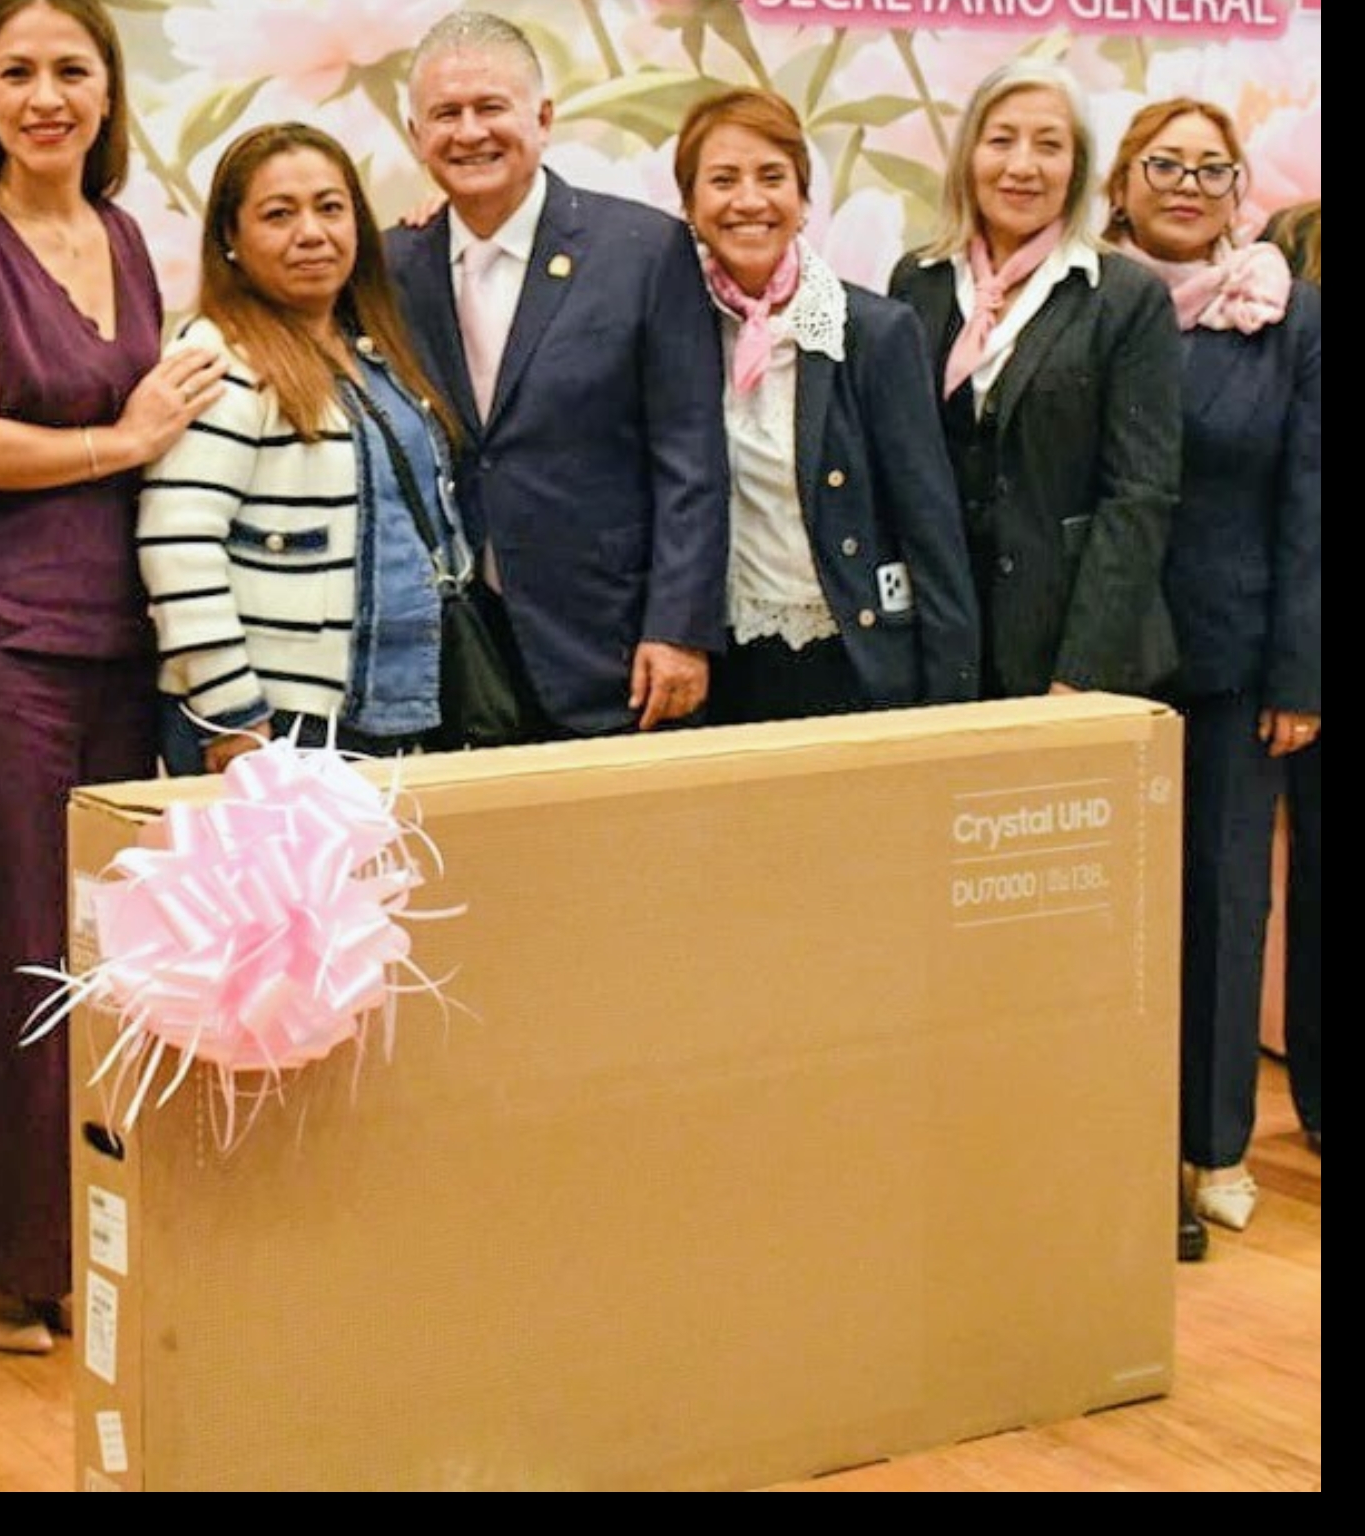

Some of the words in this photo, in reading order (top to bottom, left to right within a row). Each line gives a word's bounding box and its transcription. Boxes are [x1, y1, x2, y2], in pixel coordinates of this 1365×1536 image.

[953, 803, 1053, 850] Crystal
[1058, 797, 1112, 831] UHD
[951, 870, 1036, 907] DU7000
